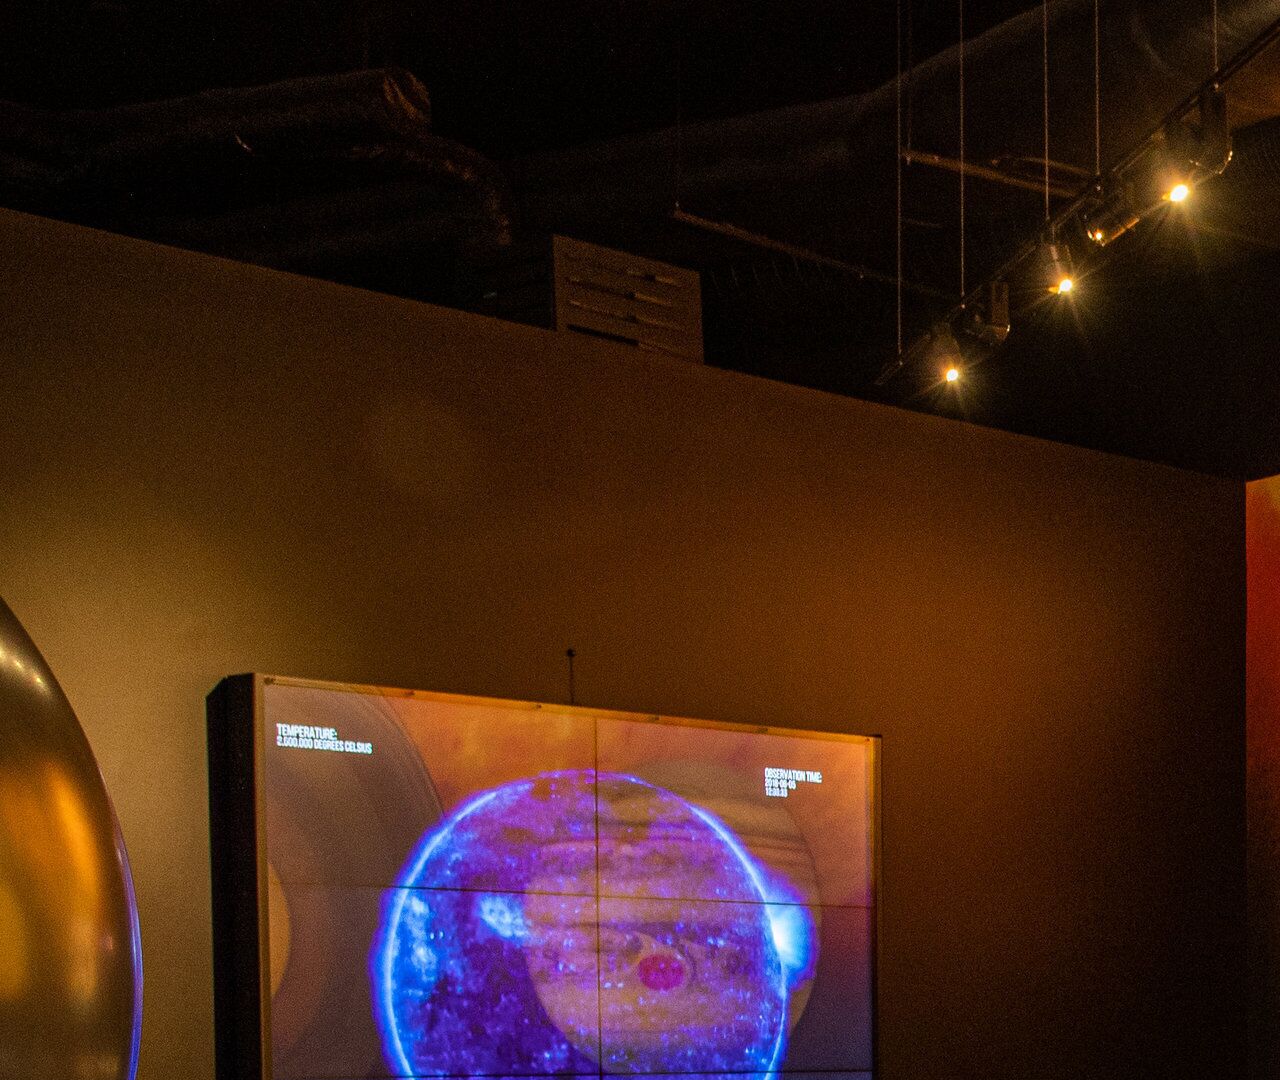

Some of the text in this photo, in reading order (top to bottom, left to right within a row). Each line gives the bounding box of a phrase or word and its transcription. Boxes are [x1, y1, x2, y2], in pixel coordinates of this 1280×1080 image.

[276, 723, 337, 741] TEMPERATURE:
[314, 739, 345, 753] DEGREES
[344, 741, 373, 755] CELSIUS
[765, 767, 822, 784] OBSERVATION TIME:
